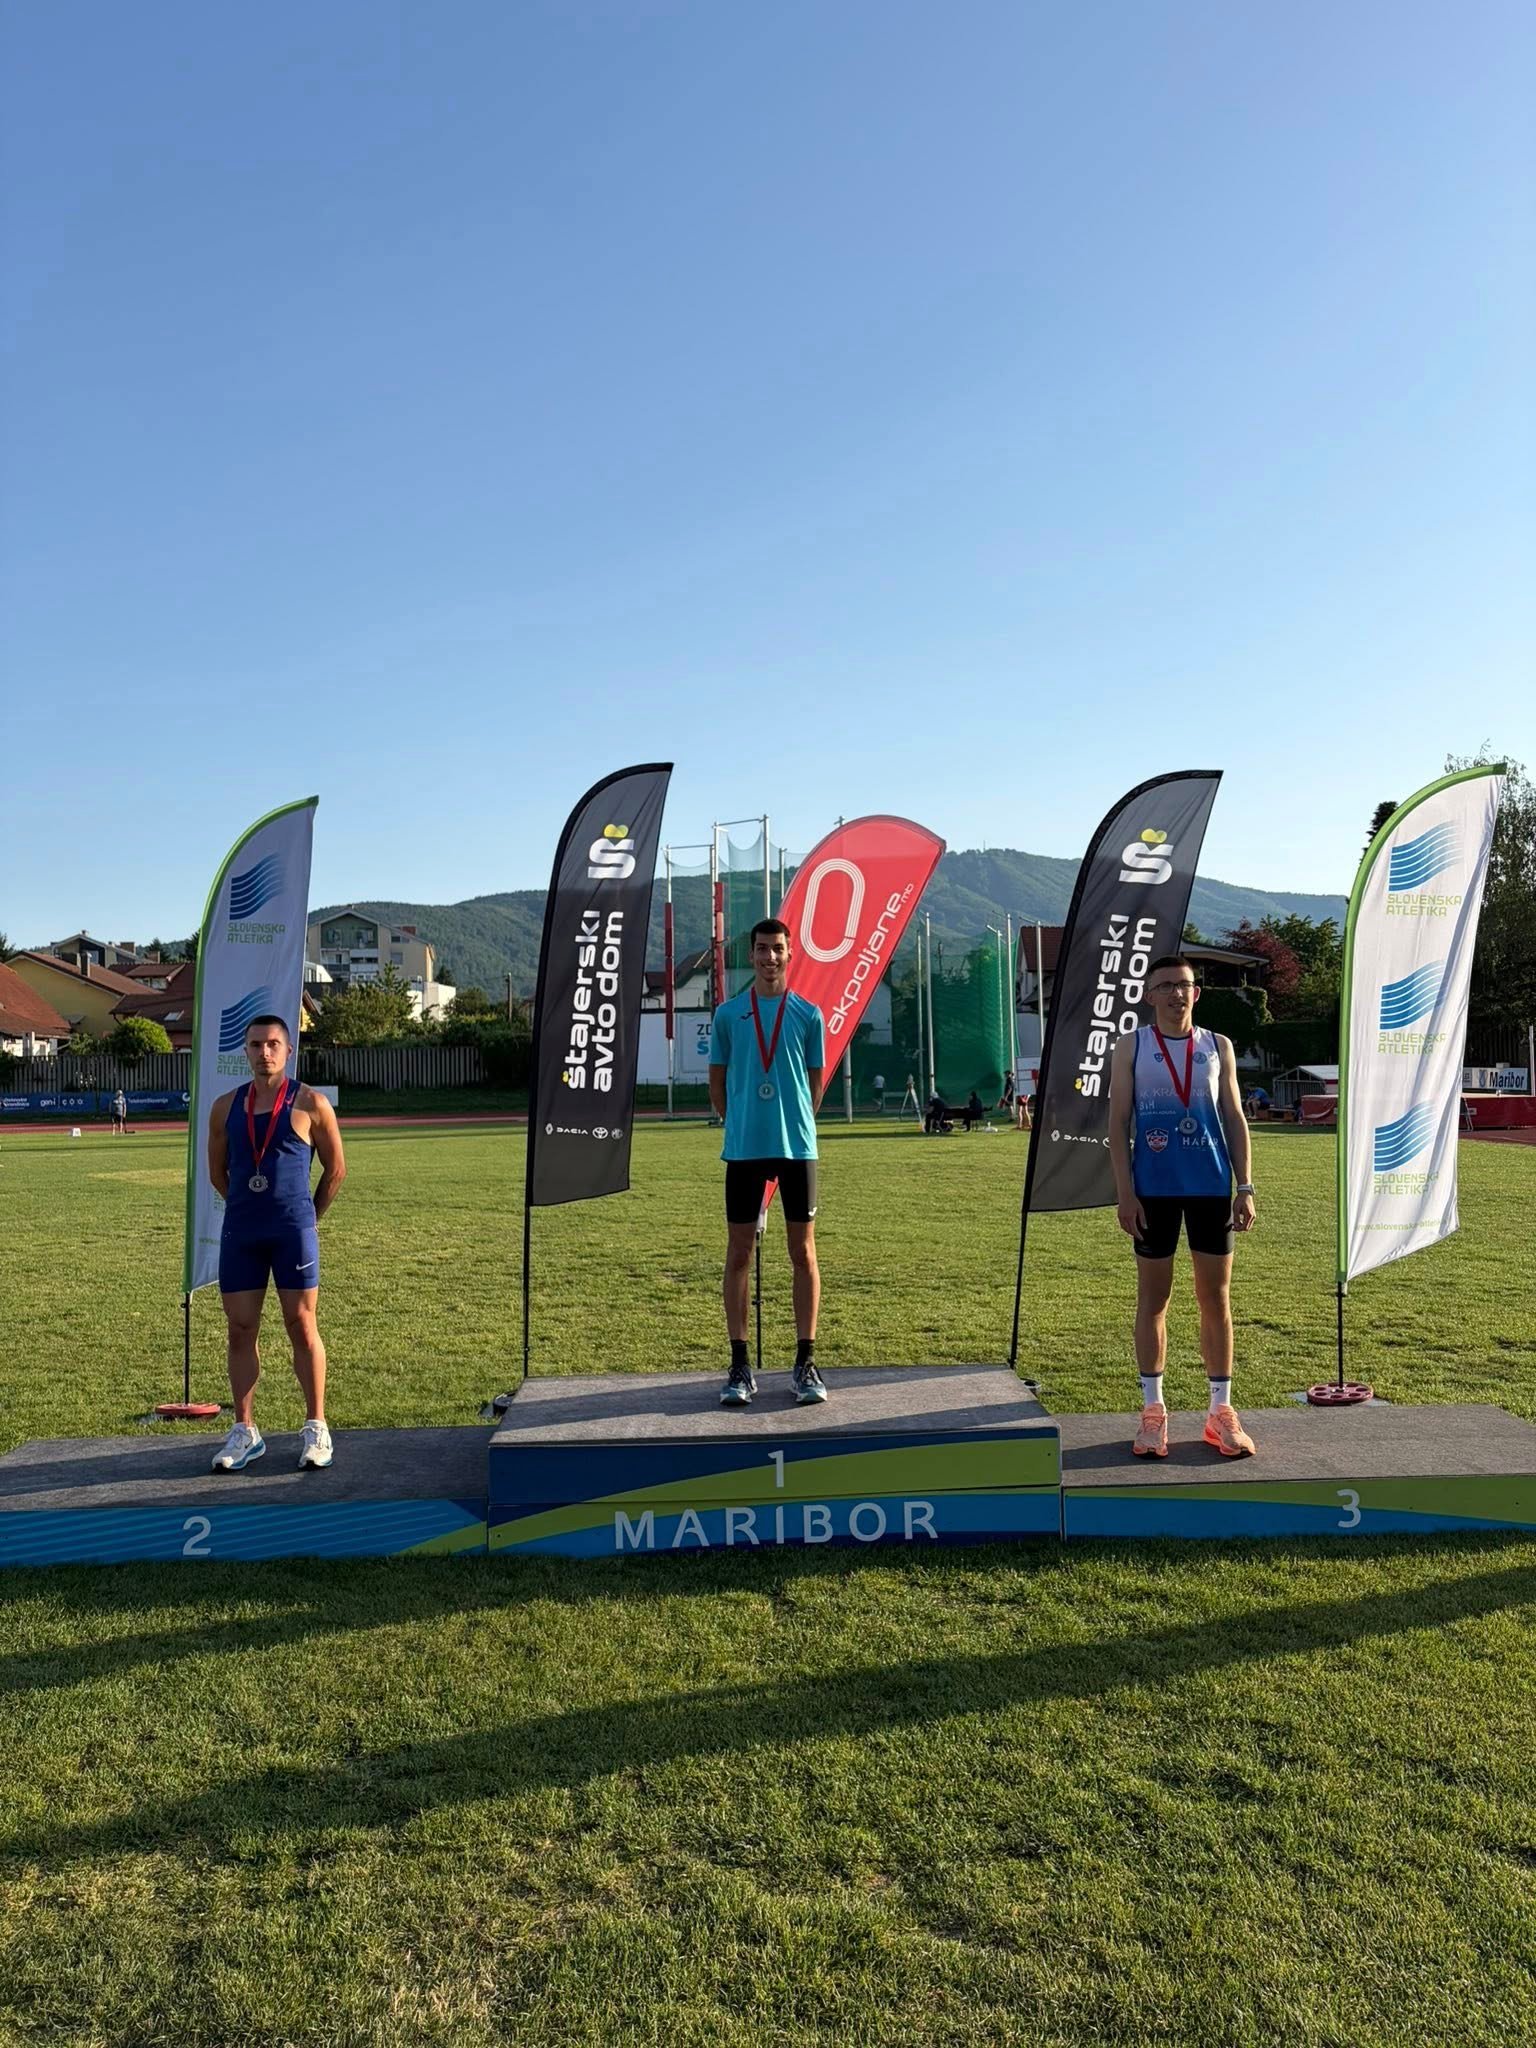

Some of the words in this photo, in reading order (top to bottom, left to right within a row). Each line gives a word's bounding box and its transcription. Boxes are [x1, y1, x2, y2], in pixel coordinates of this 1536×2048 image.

[901, 883, 914, 903] mb
[1387, 894, 1462, 905] SLOVENSKA
[1386, 905, 1447, 916] ATLETIKA
[227, 923, 285, 934] SLOVENSKA
[227, 933, 274, 944] ATLETIKA
[596, 910, 624, 997] dom
[827, 892, 902, 1035] akpoljane
[1120, 917, 1157, 1004] dom
[562, 910, 600, 1090] štajerski
[1074, 914, 1130, 1098] štajerski
[1378, 1032, 1447, 1043] SLOVENSKA
[592, 1003, 616, 1092] avto
[1377, 1043, 1434, 1054] ATLETIKA
[217, 1055, 248, 1065] SLOVE
[216, 1065, 254, 1076] ATLETIK
[1490, 1071, 1525, 1088] Maribor
[556, 1127, 588, 1135] DACIA
[1063, 1134, 1098, 1144] DACIA
[1182, 1136, 1219, 1146] HAFR
[1373, 1171, 1440, 1184] SLOVENSKA
[1373, 1184, 1429, 1195] ATLETIKA
[767, 1449, 785, 1488] 1
[1336, 1488, 1362, 1528] 3
[614, 1501, 939, 1549] MARIBOR
[182, 1515, 212, 1556] 2
